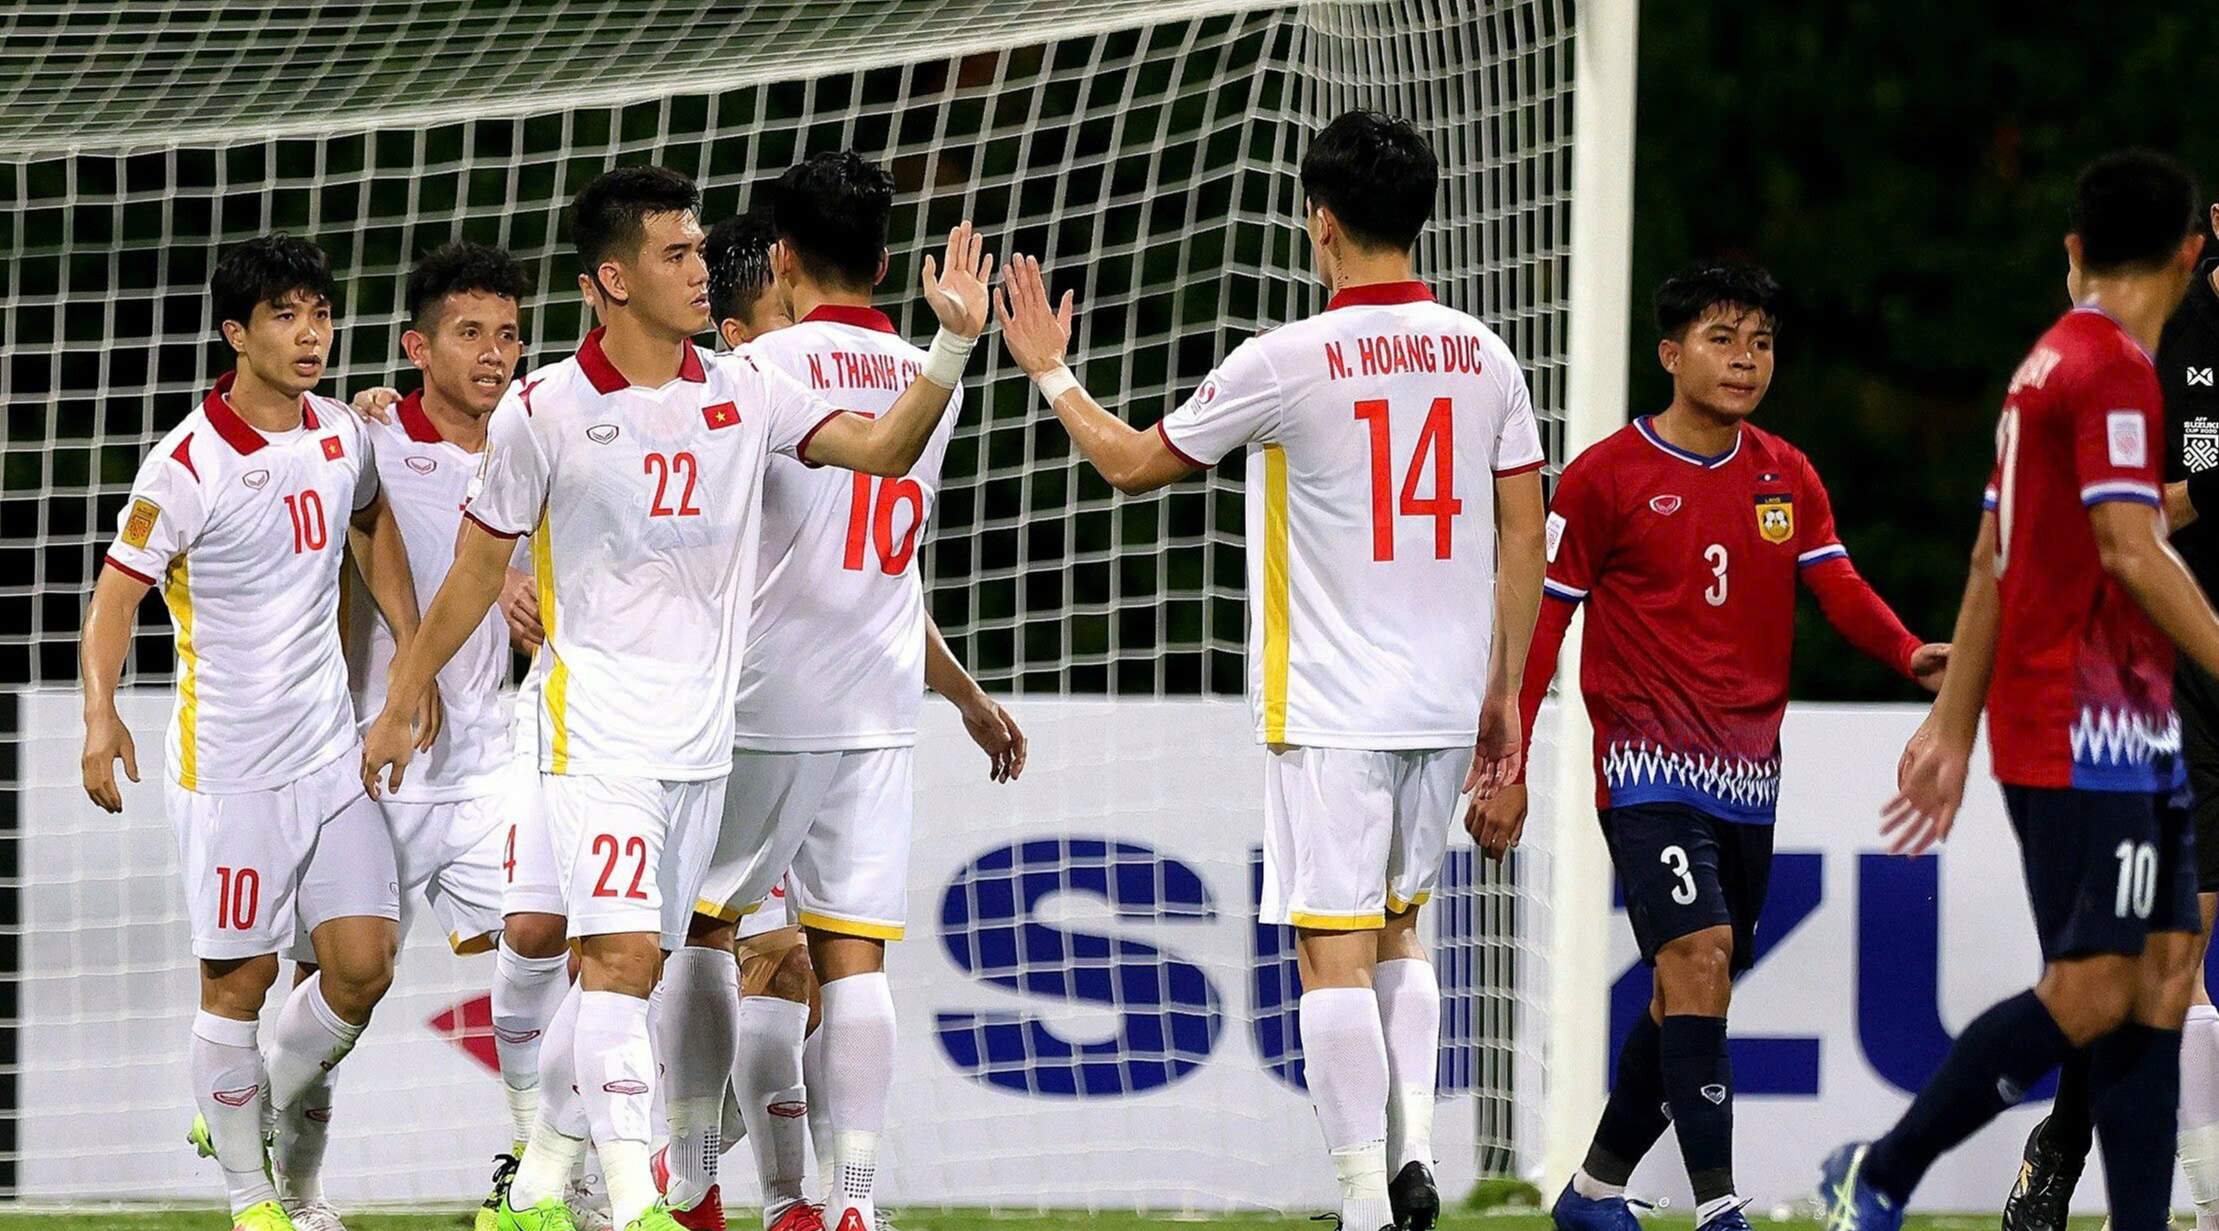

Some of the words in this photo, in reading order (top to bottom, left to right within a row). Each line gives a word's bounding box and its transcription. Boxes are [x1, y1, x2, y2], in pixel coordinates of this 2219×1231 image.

[806, 352, 831, 390] N.
[831, 351, 899, 392] THANH
[1325, 342, 1353, 380] N.
[1358, 335, 1437, 375] HOANG
[1442, 335, 1483, 376] DUC
[2184, 421, 2219, 429] SUZUKI
[644, 451, 701, 517] 22
[1353, 396, 1463, 562] 14
[283, 488, 328, 556] 10
[1703, 544, 1728, 606] 3
[216, 866, 260, 931] 10
[592, 833, 648, 900] 22
[1660, 844, 1698, 905] 3
[2115, 840, 2159, 918] 10
